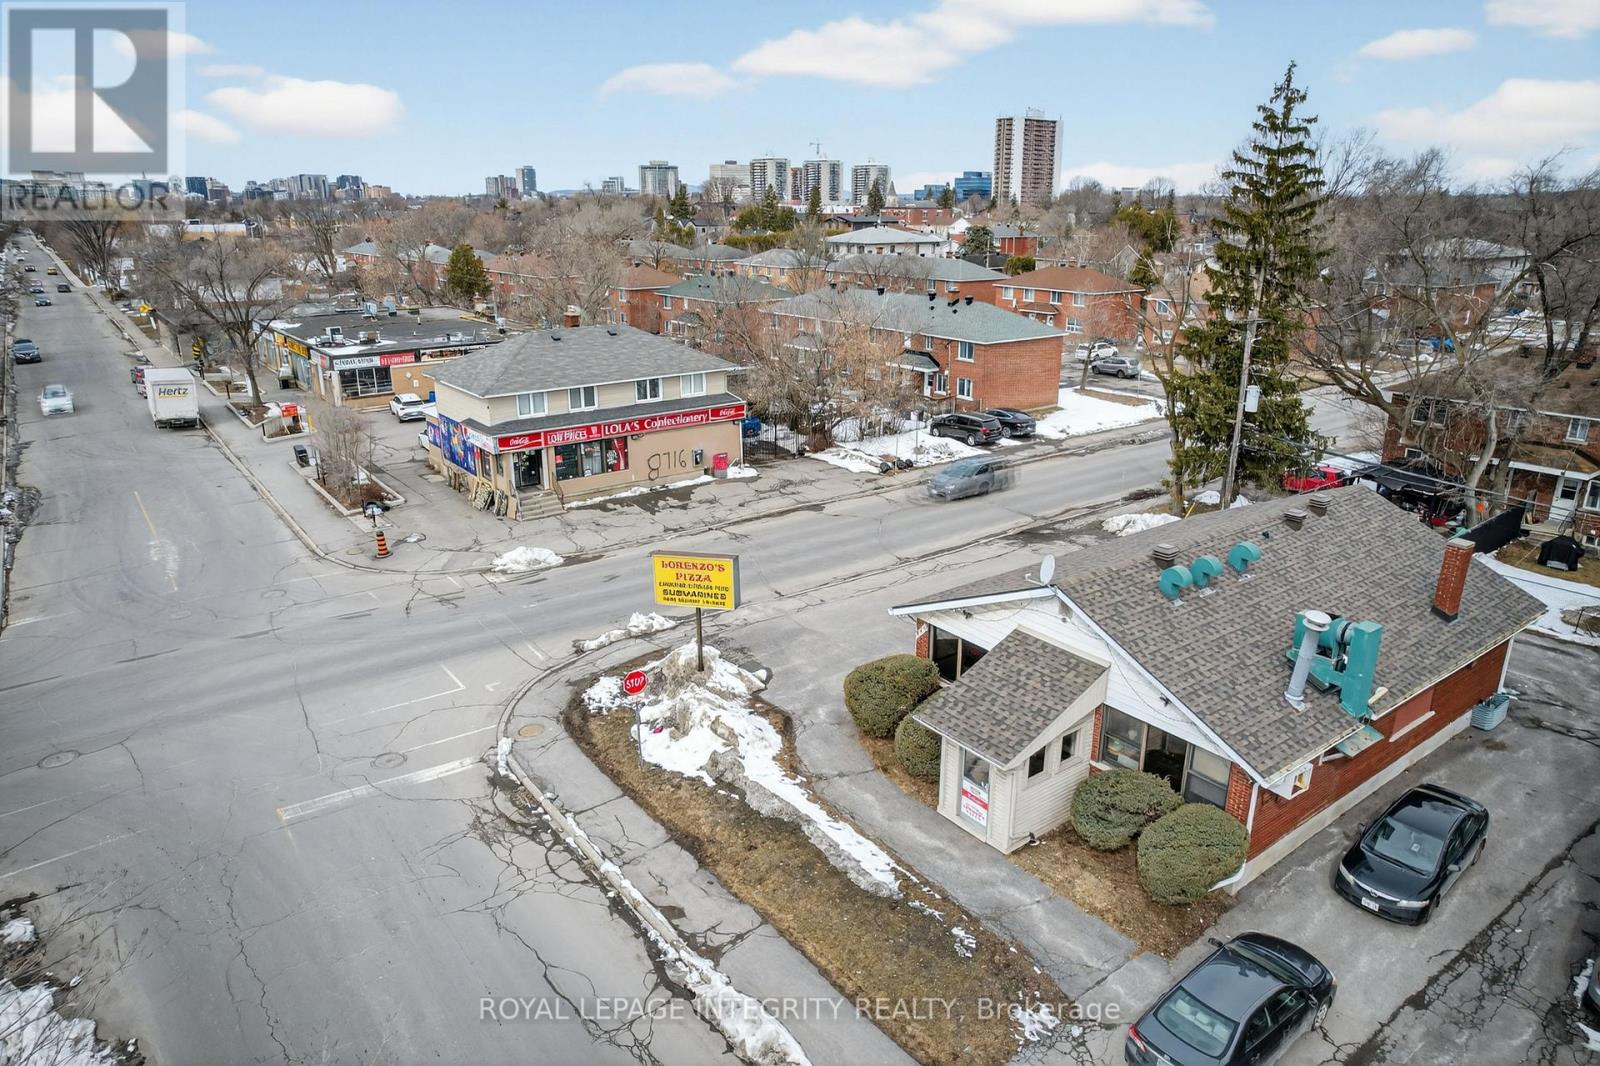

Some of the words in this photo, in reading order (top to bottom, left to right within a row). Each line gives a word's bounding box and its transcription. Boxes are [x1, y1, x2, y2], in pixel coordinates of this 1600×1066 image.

[159, 386, 189, 396] Hertz
[605, 420, 640, 435] LOLA'S
[644, 413, 708, 429] Confectionery
[547, 432, 563, 444] LOW
[661, 560, 725, 573] LORENZO'S
[675, 573, 712, 583] PIZZA
[662, 588, 727, 600] SUBMARINES
[626, 675, 645, 689] STOP
